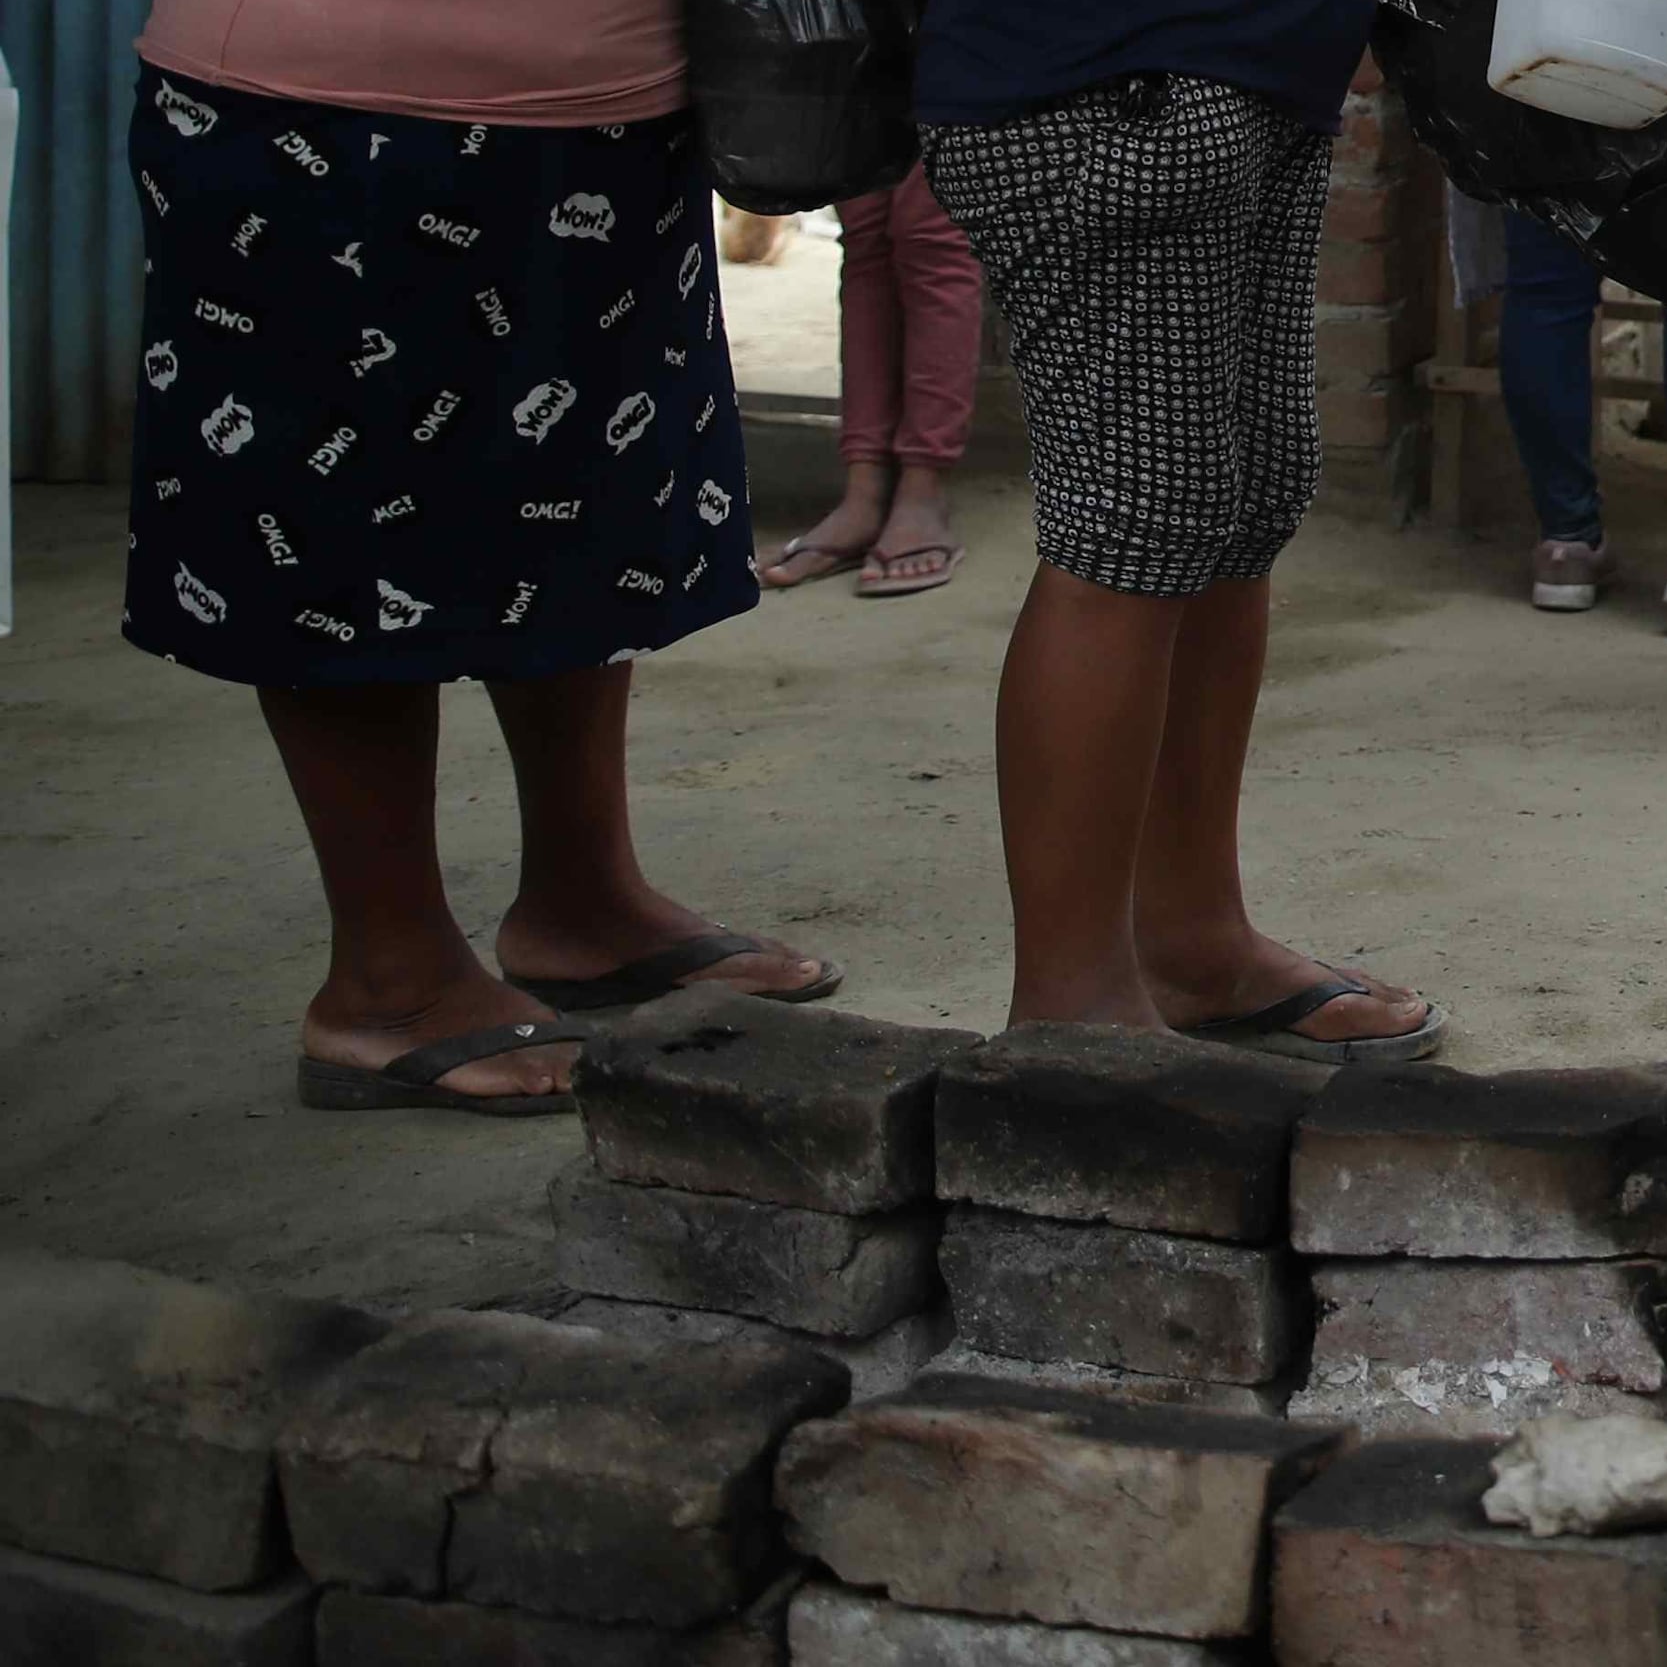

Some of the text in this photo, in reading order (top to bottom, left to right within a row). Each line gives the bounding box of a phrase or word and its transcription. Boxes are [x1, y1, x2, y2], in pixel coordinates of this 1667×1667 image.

[273, 131, 329, 176] OMG!
[231, 213, 268, 257] WOW!
[418, 213, 481, 248] OMG!
[555, 204, 610, 231] WOW!
[655, 197, 685, 235] OMG!
[195, 297, 254, 334] OMG!
[475, 287, 511, 336] OMG!
[599, 289, 636, 329] OMG!
[413, 389, 461, 442] OMG!
[517, 377, 571, 433] WOW!
[610, 395, 652, 441] OMG!
[695, 394, 716, 433] OMG!
[207, 406, 251, 455] WOW!
[307, 427, 357, 476] OMG!
[520, 500, 582, 520] OMG!
[257, 513, 299, 566] OMG!
[616, 568, 665, 595] OMG!
[682, 553, 709, 592] WOW!
[501, 580, 538, 624] WOW!
[294, 609, 355, 642] OMG!
